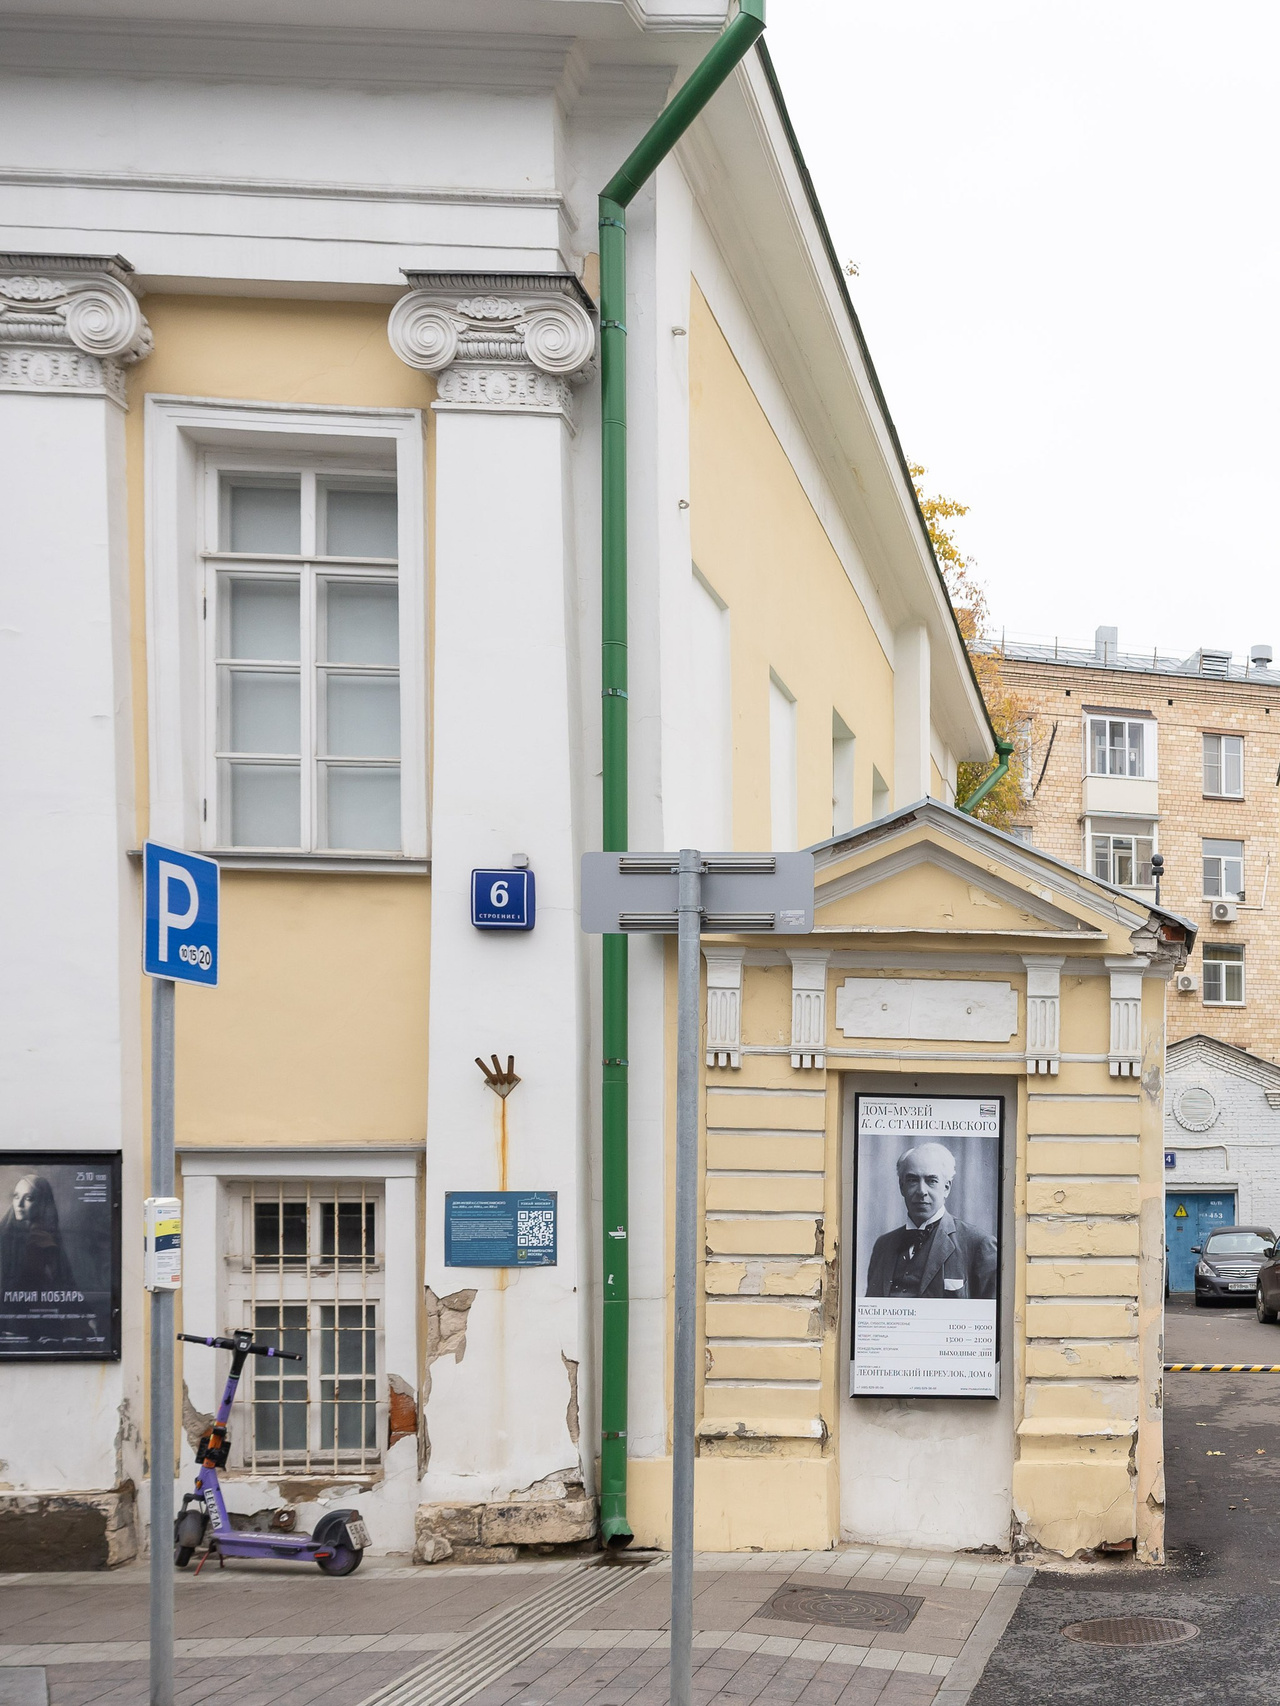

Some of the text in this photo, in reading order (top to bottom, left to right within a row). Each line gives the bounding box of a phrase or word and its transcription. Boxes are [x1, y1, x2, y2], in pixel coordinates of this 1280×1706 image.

[490, 880, 509, 907] 6
[158, 860, 199, 962] P
[181, 948, 211, 965] 10 15 20
[861, 1104, 933, 1117] ДОМ-МУЗЕЙ
[861, 1118, 997, 1132] К. С. СТАНИСЛАВСКОГО
[3, 1291, 85, 1302] МАРИЯ КОБЗАРЬ
[858, 1308, 917, 1316] ЧАСЫ РАБОТЫ:
[974, 1324, 993, 1332] 19:00
[977, 1350, 992, 1358] ДНИ
[856, 1367, 992, 1378] ЛЕОНТЬЕВСКИЙ ПЕРЕУЛОК, ДОМ 6
